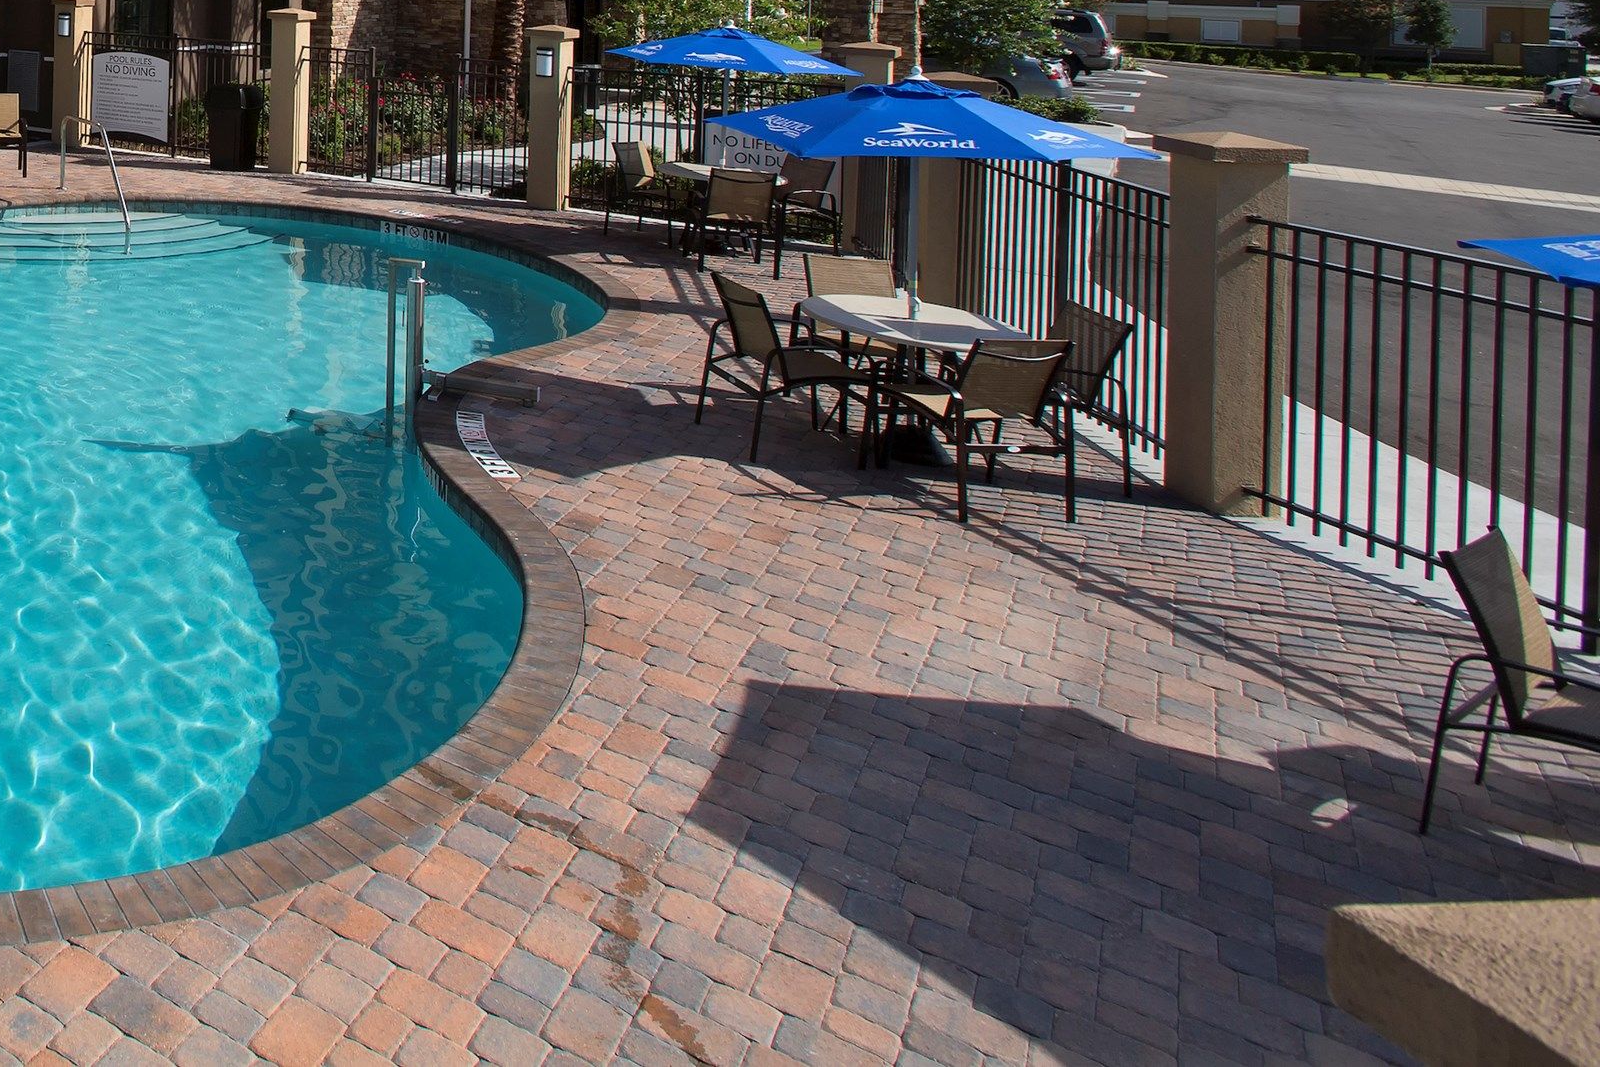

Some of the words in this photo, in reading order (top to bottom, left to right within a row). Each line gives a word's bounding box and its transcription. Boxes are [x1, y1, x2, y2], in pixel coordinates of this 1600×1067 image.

[109, 55, 129, 63] POOL
[130, 56, 153, 66] RULES
[105, 64, 121, 74] NO
[122, 65, 156, 77] DIVING
[713, 134, 738, 147] NO
[863, 137, 977, 149] SeaWorld
[734, 152, 760, 166] ON
[384, 223, 390, 233] 3
[395, 224, 407, 236] FT
[423, 229, 433, 241] 09
[436, 232, 447, 244] M
